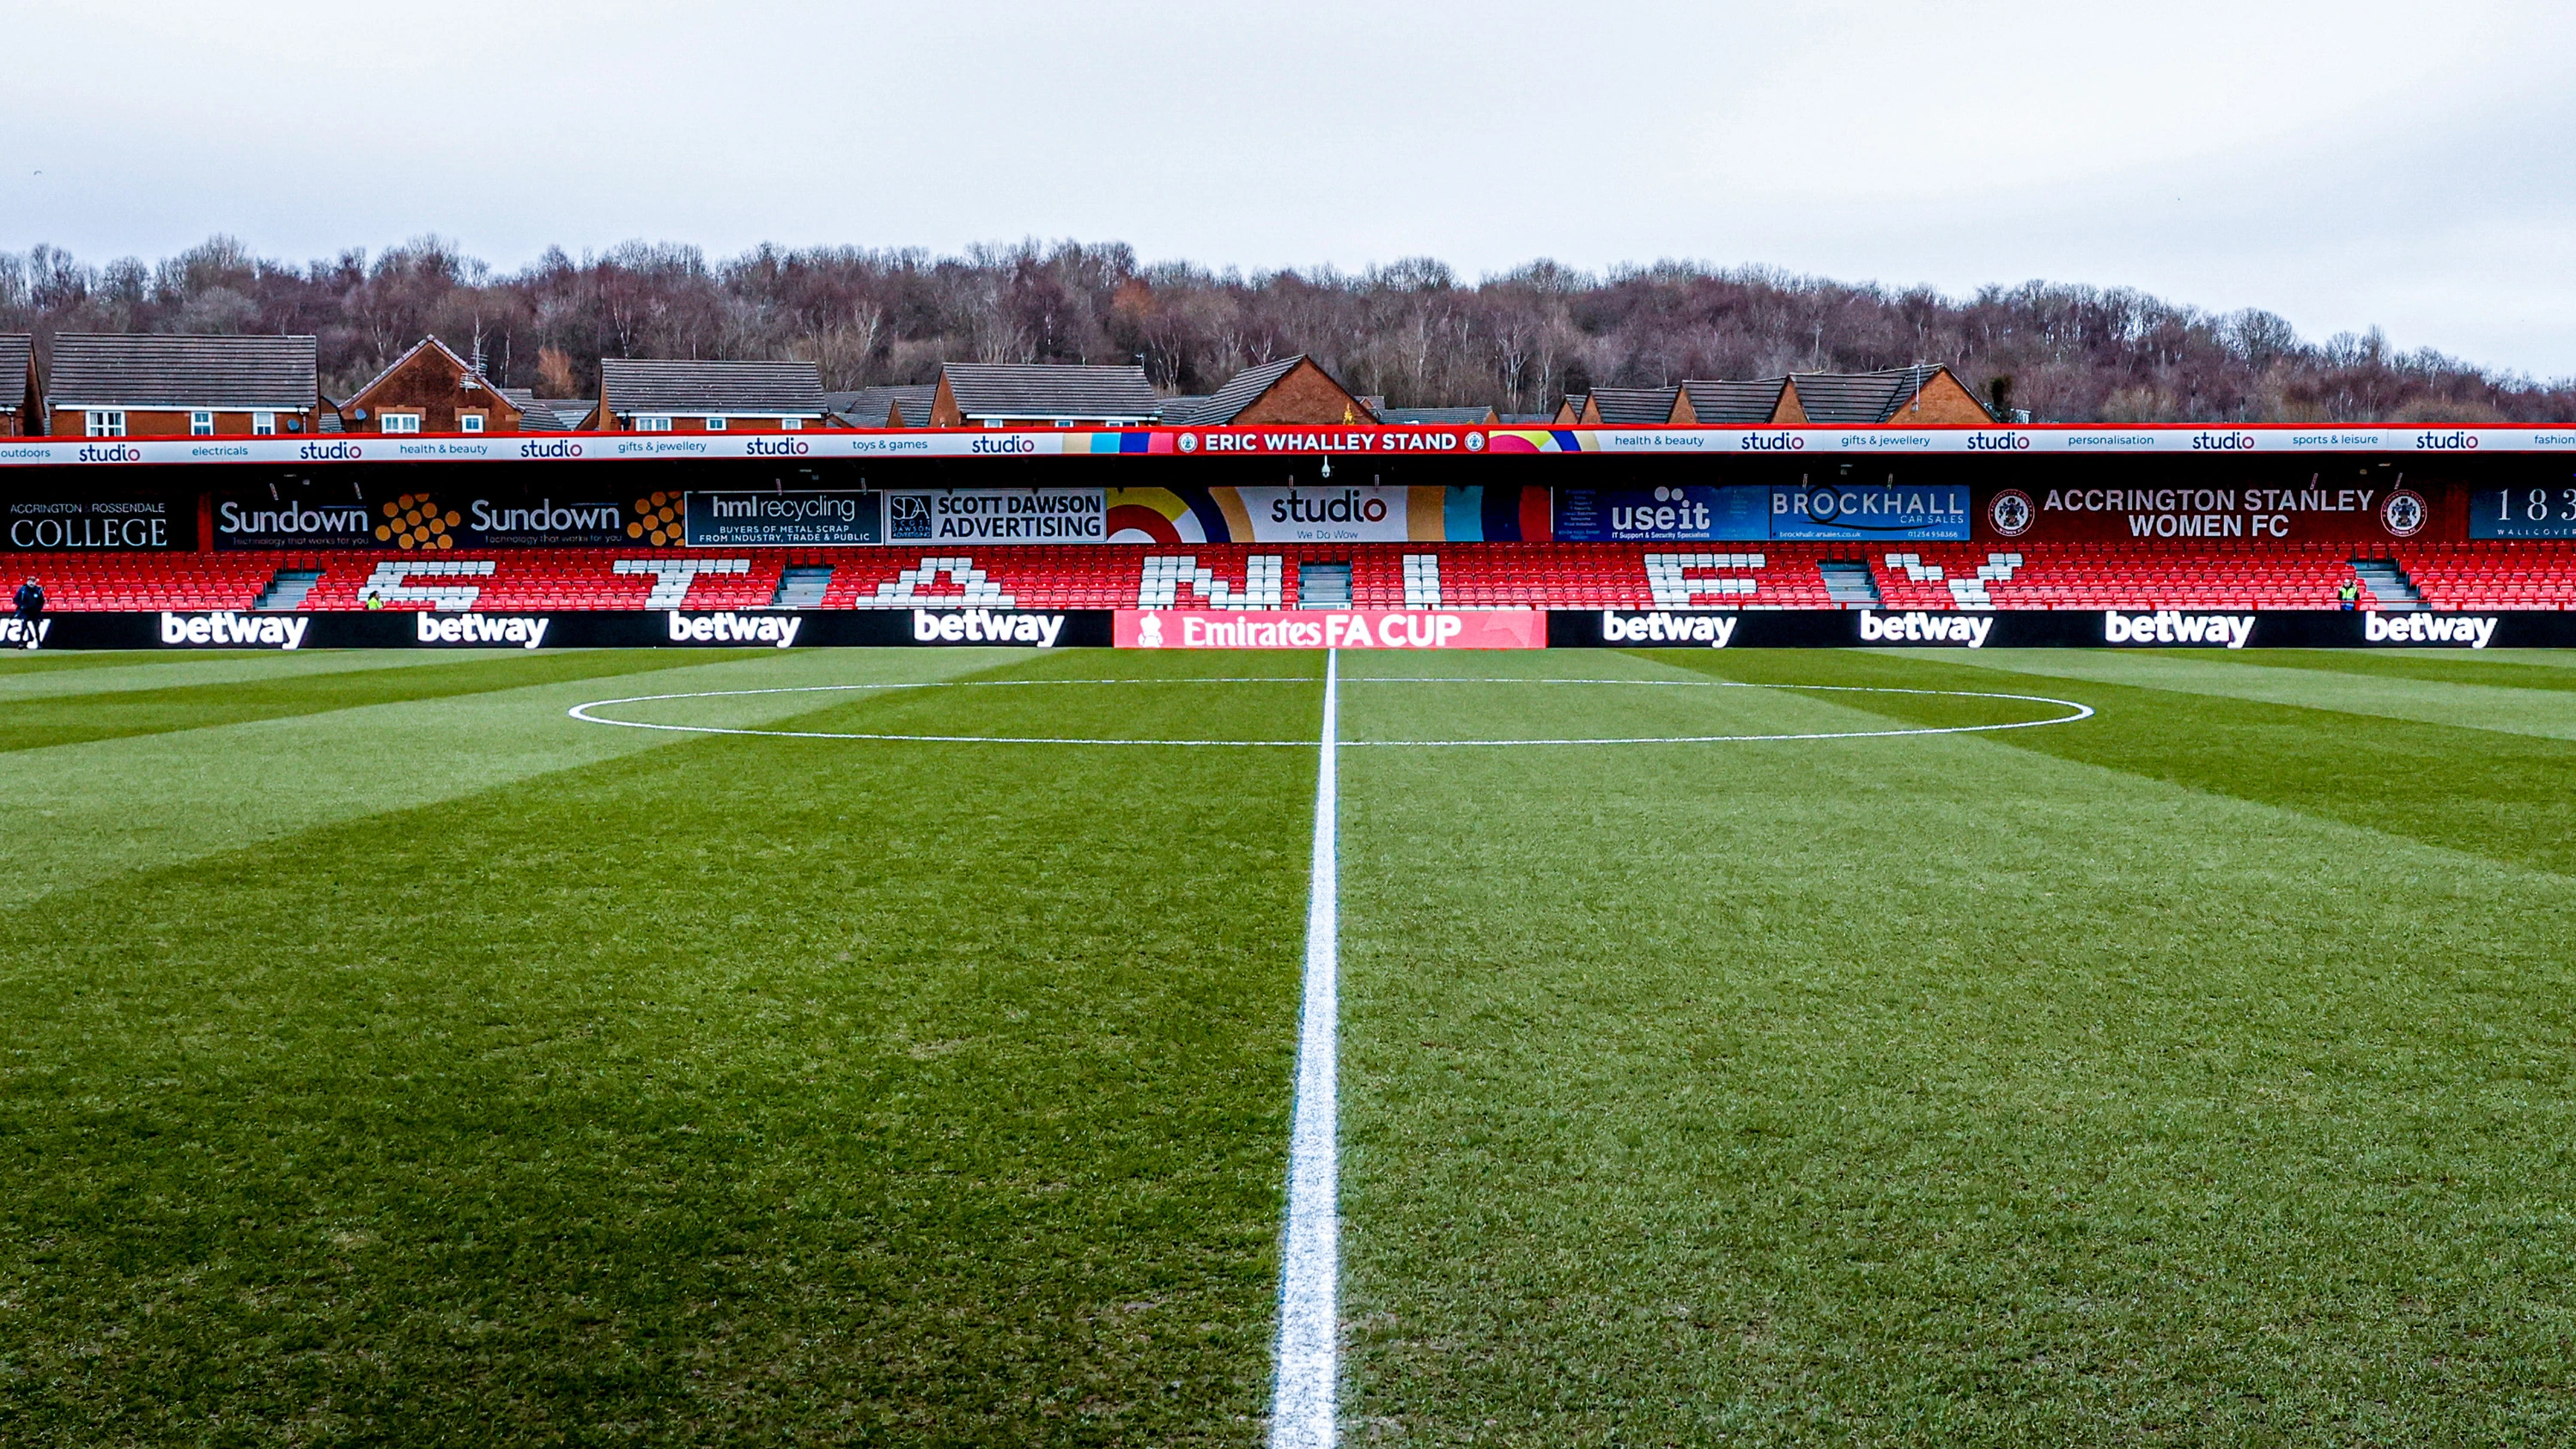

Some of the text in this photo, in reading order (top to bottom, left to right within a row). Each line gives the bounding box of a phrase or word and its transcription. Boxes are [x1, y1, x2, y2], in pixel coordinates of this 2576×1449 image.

[618, 441, 707, 453] gifts & jewellery
[747, 437, 809, 455] studio
[853, 439, 927, 451] toys & games
[972, 435, 1035, 454] studio
[1206, 433, 1457, 450] ERIC WHALLEY STAND
[1615, 435, 1704, 447] health & beauty
[1741, 432, 1804, 450] studio
[1841, 435, 1930, 447] gifts & jewellery
[1967, 432, 2030, 449] studio
[2069, 435, 2154, 447] personalisation
[2192, 431, 2255, 449] studio
[2293, 435, 2379, 446] sports & leisure
[2416, 431, 2478, 449] studio
[2535, 435, 2575, 444] fashion
[1, 448, 51, 457] outdoors
[79, 444, 140, 462] studio
[192, 445, 248, 456] electricals
[301, 441, 361, 460] studio
[400, 443, 488, 455] health & beauty
[521, 440, 582, 458] studio
[10, 503, 82, 514] ACCRINGTON
[92, 502, 166, 514] ROSSENDALE
[893, 496, 929, 520] SDA
[939, 495, 1100, 514] SCOTT DAWSON
[1272, 490, 1387, 522] studio
[1773, 493, 1964, 514] BROCKHALL
[2044, 490, 2234, 511] ACCRINGTON
[2245, 490, 2373, 511] STANLEY
[220, 500, 368, 533] Sundown
[471, 498, 620, 531] Sundown
[1928, 515, 1964, 524] SALES
[10, 519, 167, 547] COLLEGE
[939, 517, 1100, 537] ADVERTISING
[1297, 530, 1358, 539] We Do Wow
[2129, 514, 2289, 537] WOMEN FC
[352, 538, 369, 547] you
[605, 535, 623, 544] you
[161, 612, 308, 650] betway
[417, 612, 550, 649] betway
[669, 611, 802, 648] betway
[914, 609, 1065, 648] betway
[1183, 614, 1461, 647] Emirates FA CUP
[1603, 611, 1737, 648] betway
[1860, 610, 1994, 648] betway
[2105, 611, 2256, 648] betway
[2365, 611, 2498, 649] betway
